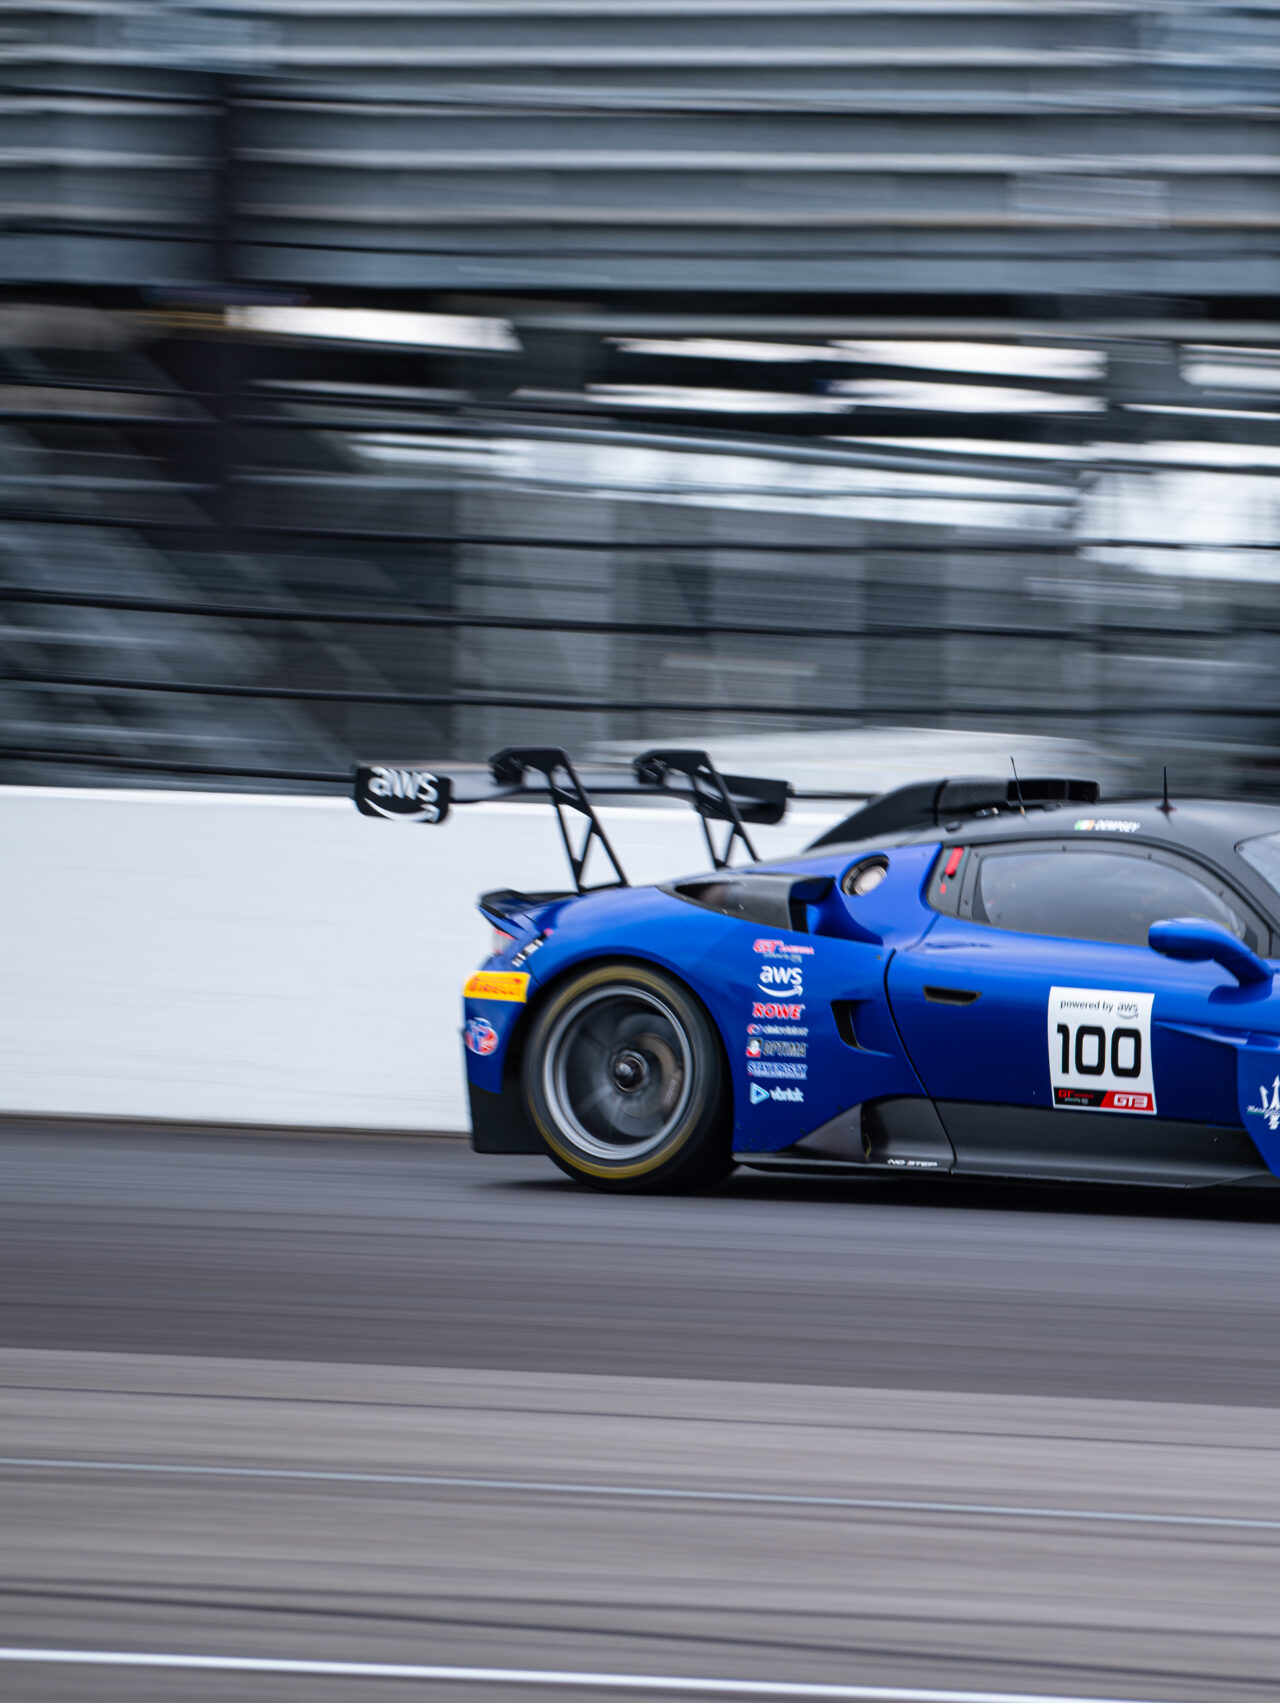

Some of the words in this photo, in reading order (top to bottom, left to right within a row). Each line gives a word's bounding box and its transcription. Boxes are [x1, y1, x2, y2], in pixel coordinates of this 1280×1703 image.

[367, 766, 440, 803] aws
[759, 965, 803, 985] aws
[751, 1002, 803, 1020] ROWE
[1060, 1000, 1100, 1010] powered
[1102, 1000, 1114, 1014] by
[1056, 1023, 1142, 1079] 100
[1113, 1093, 1149, 1109] GT3
